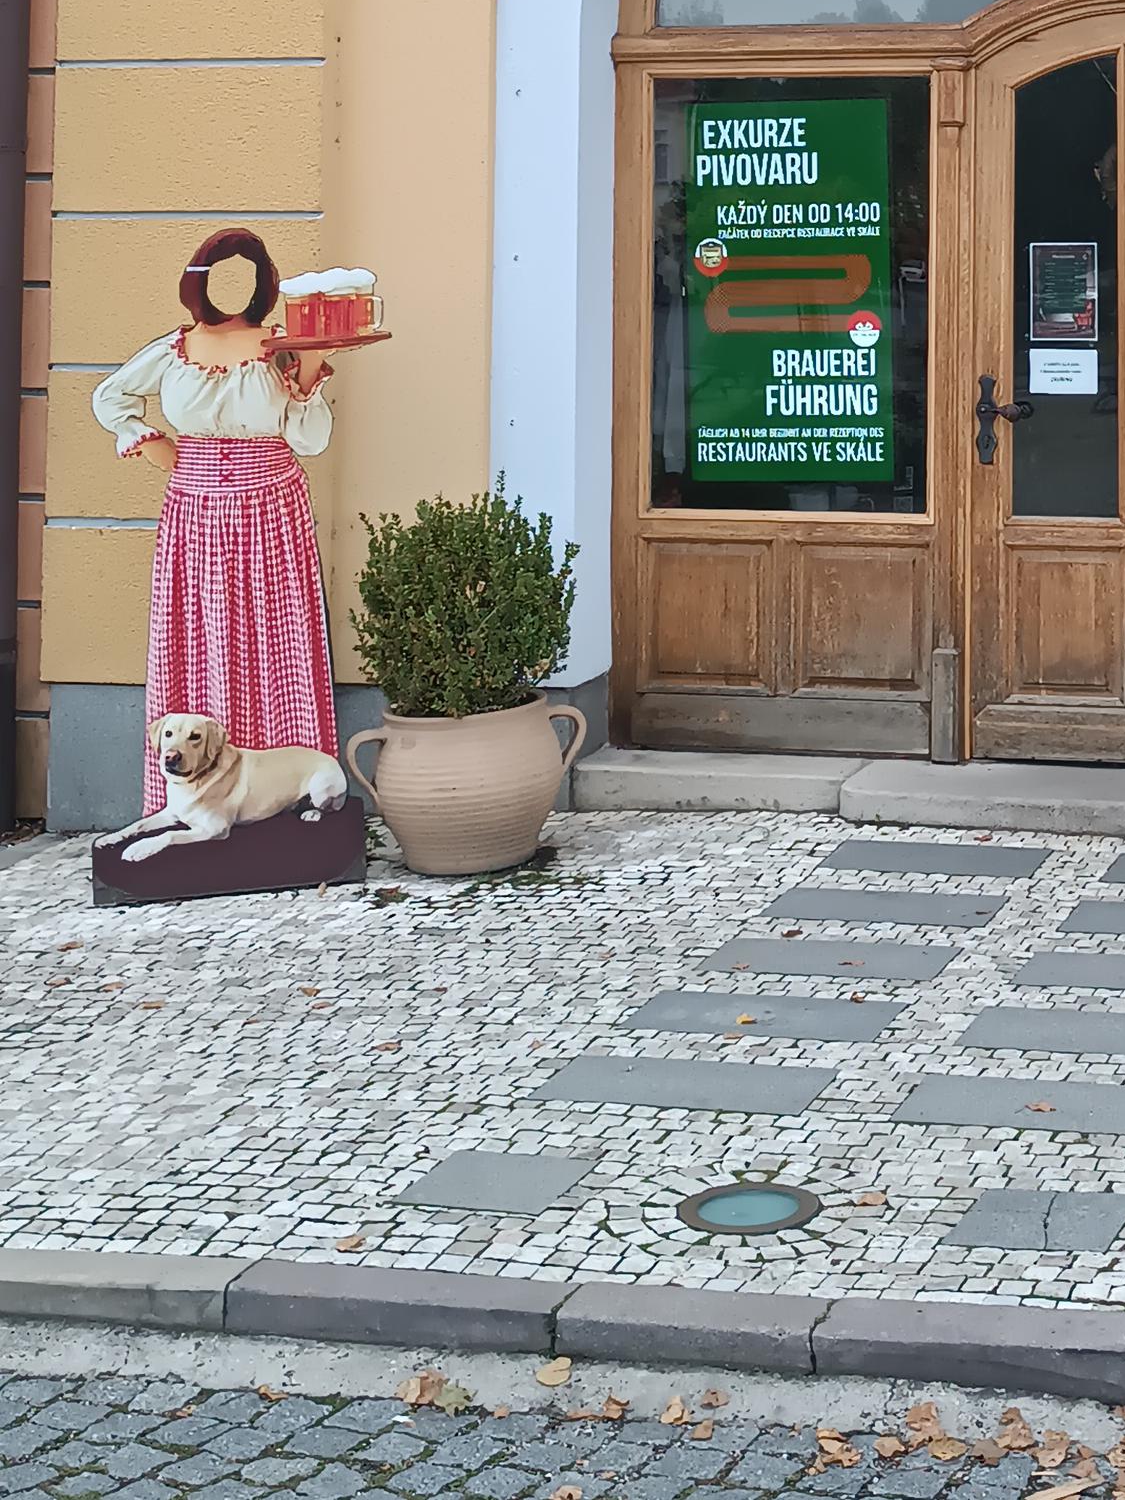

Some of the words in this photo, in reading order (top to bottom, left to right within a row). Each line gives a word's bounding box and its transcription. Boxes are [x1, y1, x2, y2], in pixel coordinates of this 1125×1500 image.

[703, 118, 807, 149] EXKURZE
[696, 151, 818, 187] PIVOVARU
[717, 199, 767, 225] KAŽDÝ
[772, 203, 803, 225] DEN
[808, 203, 831, 224] OD
[835, 202, 881, 224] 14:00
[772, 348, 876, 378] BRAUEREI
[765, 379, 878, 417] FÜHRUNG
[697, 441, 808, 462] RESTAURANTS
[812, 441, 832, 462] VE
[836, 436, 885, 462] SKÁLE
